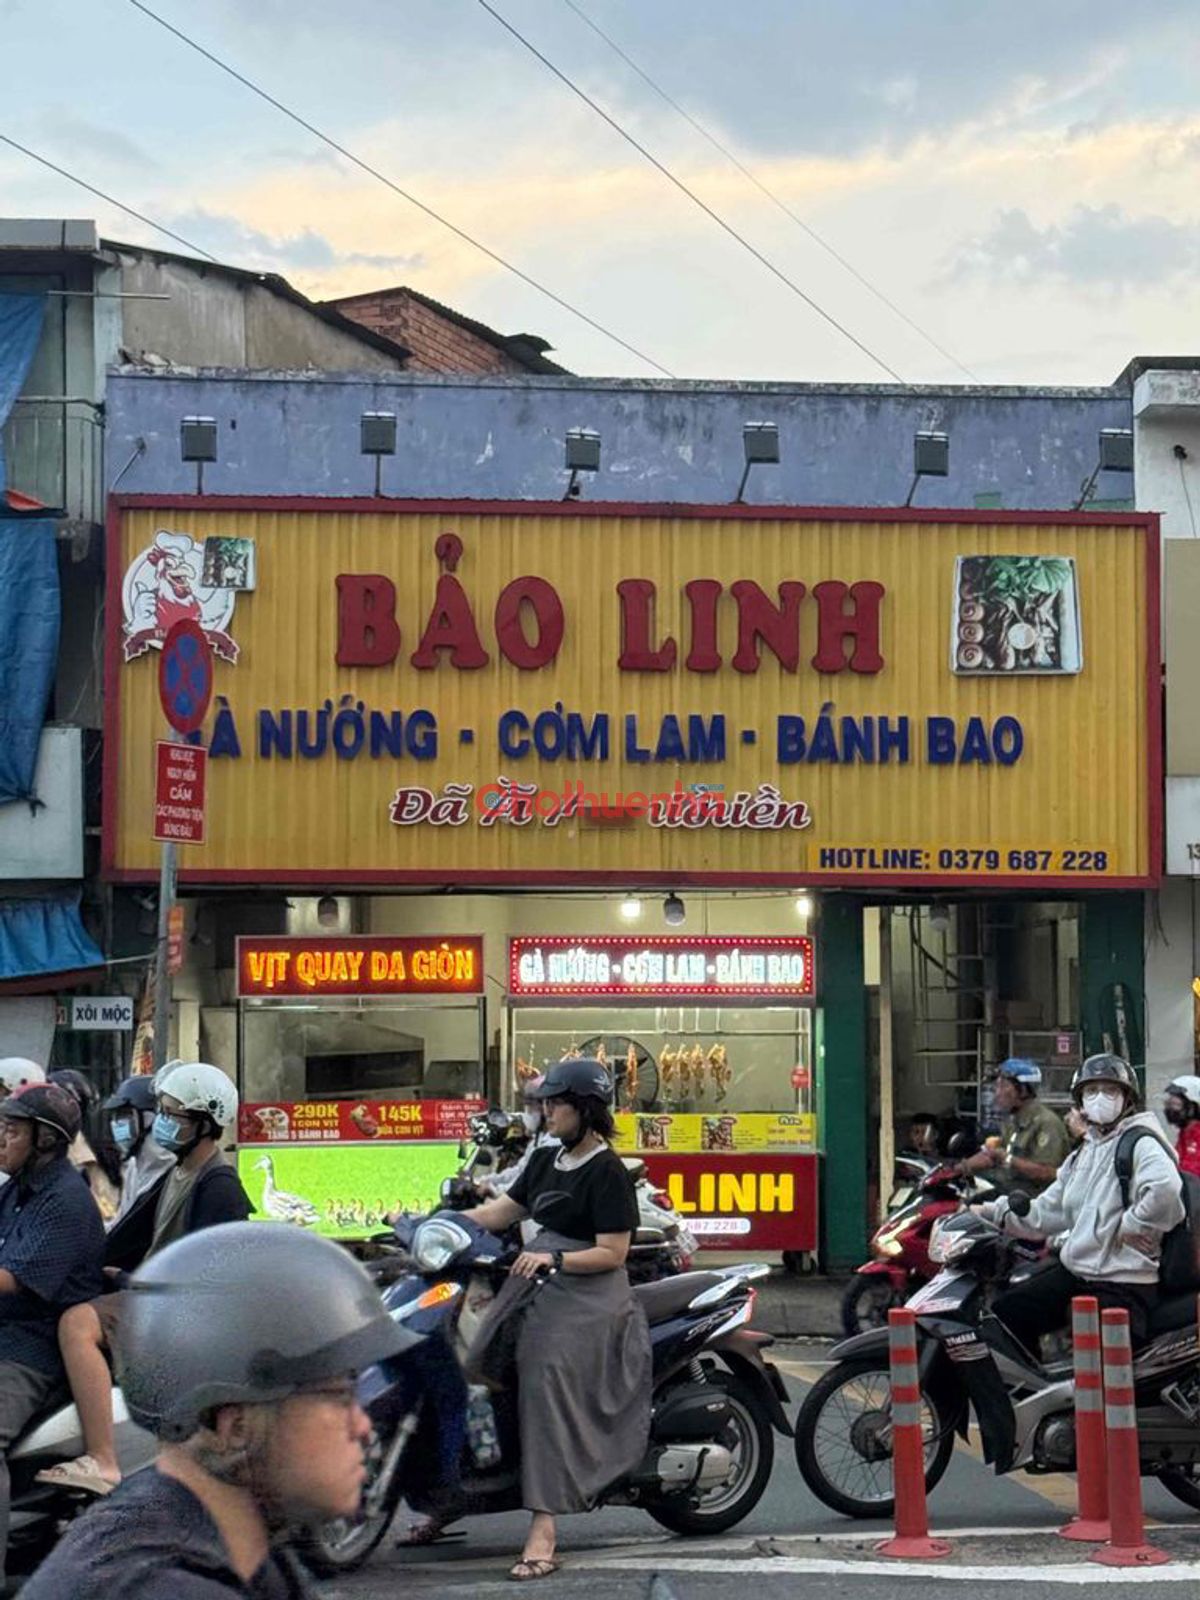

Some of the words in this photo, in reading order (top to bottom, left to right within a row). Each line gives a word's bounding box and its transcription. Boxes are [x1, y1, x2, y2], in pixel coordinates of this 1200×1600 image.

[335, 532, 566, 672] BẢO
[616, 578, 886, 674] LINH
[258, 694, 438, 760] NƯỚNG
[498, 701, 610, 762] CƠM
[625, 713, 727, 763] LAM
[776, 702, 910, 765] BÁNH
[926, 715, 1025, 766] BAO
[169, 782, 193, 801] CẤM
[389, 783, 474, 826] Đã
[819, 847, 931, 870] HOTLINE:
[938, 849, 1000, 871] 0379
[1007, 850, 1052, 871] 687
[1061, 850, 1108, 872] 228
[248, 951, 291, 988] VỊT
[296, 951, 365, 987] QUAY
[371, 951, 406, 981] DA
[767, 954, 804, 984] BAO
[75, 1003, 98, 1021] XÔI
[101, 1003, 131, 1025] MỘC
[293, 1103, 339, 1119] 290K
[378, 1104, 422, 1121] 145K
[668, 1172, 795, 1213] LINH
